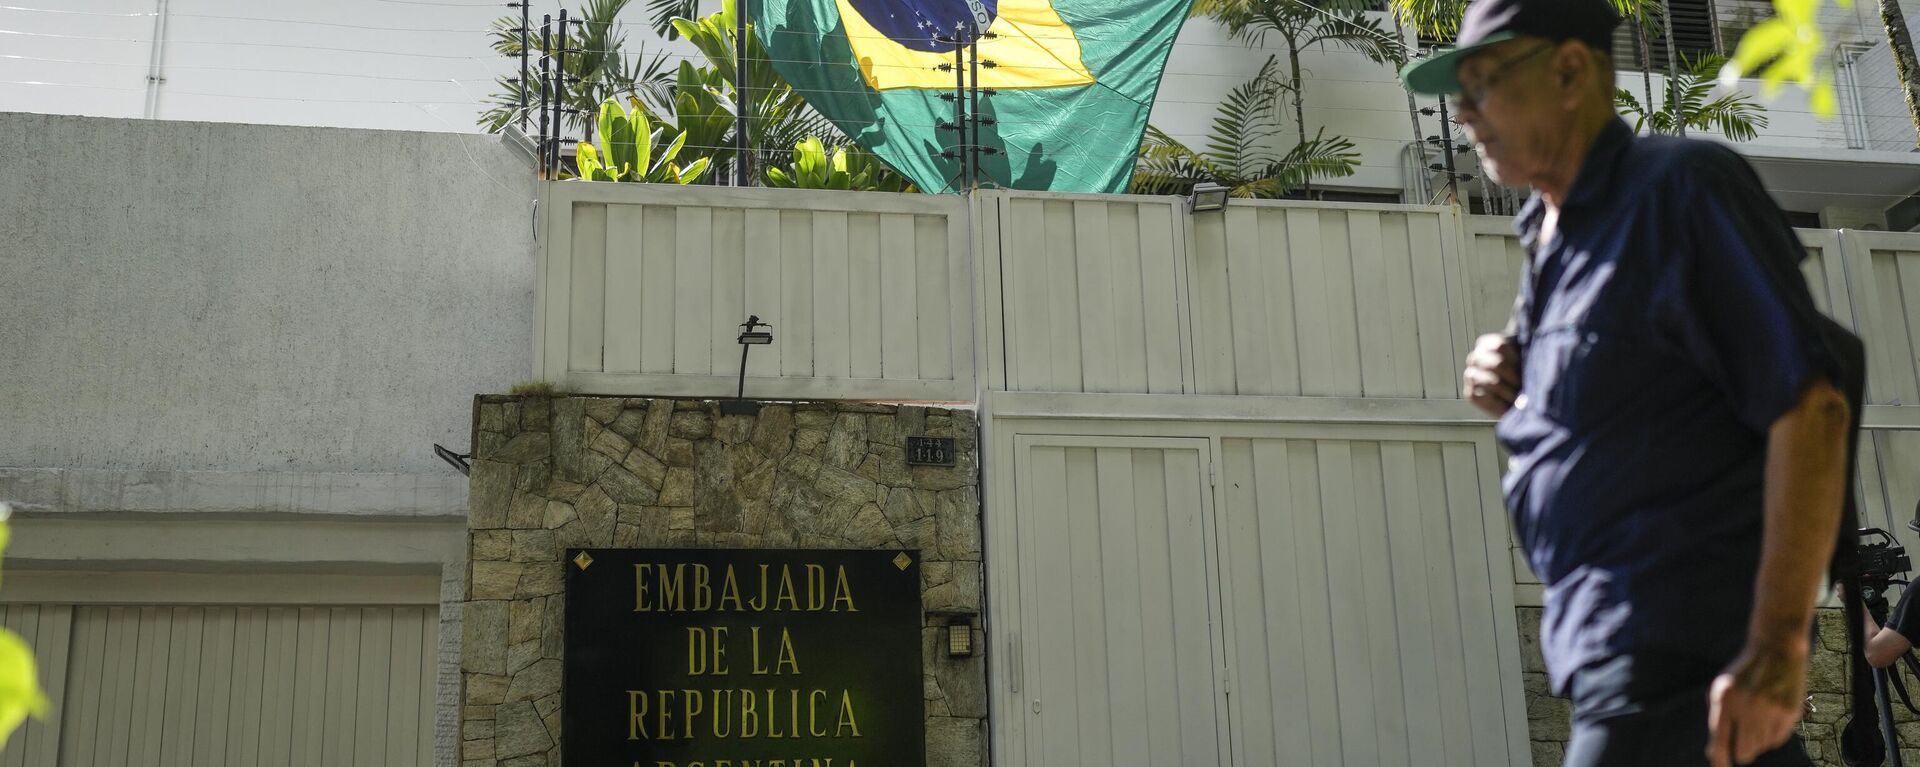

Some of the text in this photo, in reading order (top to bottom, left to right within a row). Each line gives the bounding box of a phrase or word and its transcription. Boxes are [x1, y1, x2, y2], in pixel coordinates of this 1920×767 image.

[633, 563, 859, 612] EMBAJADA
[687, 626, 801, 675] DE LA
[626, 688, 863, 740] REPUBLICA
